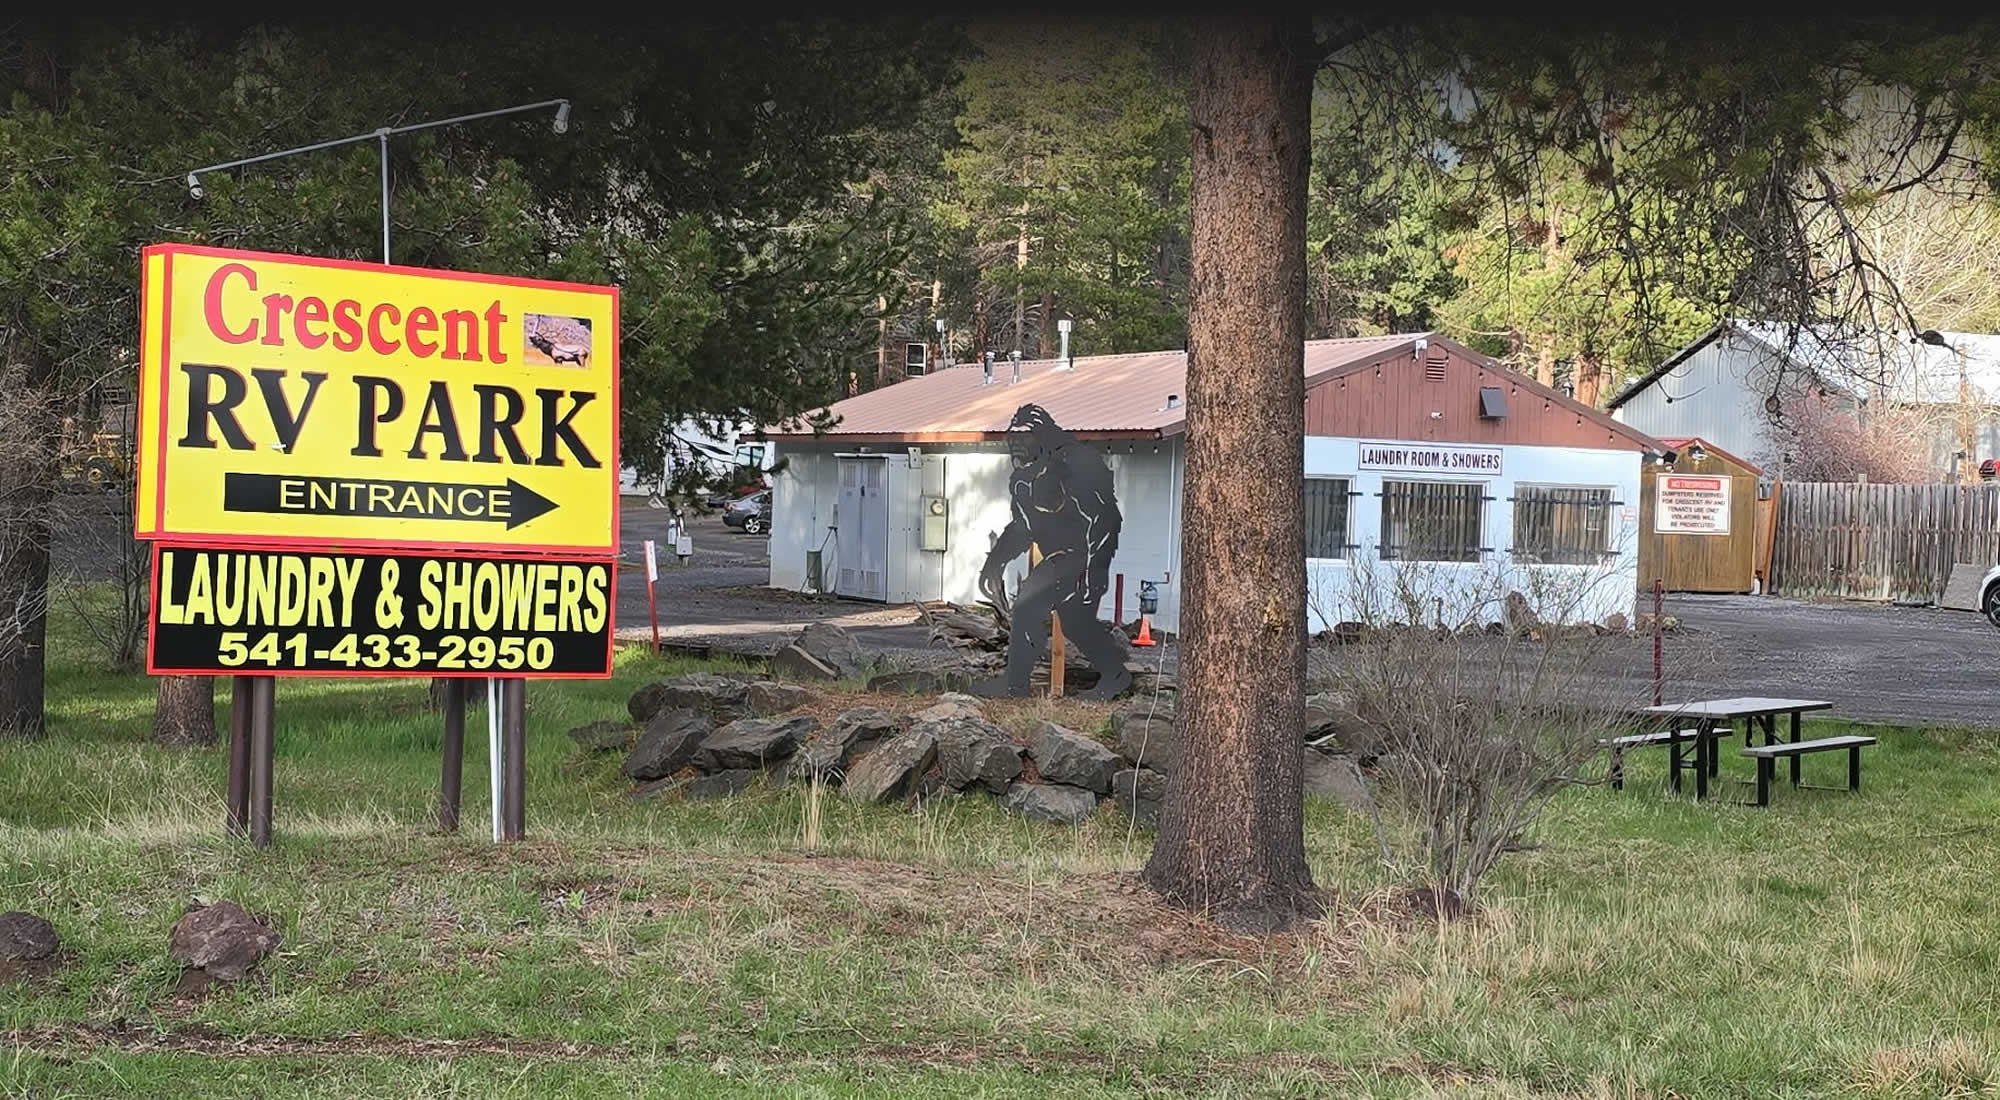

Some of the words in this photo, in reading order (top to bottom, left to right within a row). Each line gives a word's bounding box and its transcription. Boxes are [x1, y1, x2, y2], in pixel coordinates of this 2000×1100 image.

[204, 263, 507, 363] Crescent
[178, 363, 328, 454] RV
[351, 375, 602, 468] PARK
[1362, 449, 1409, 465] LAUNDRY
[1411, 452, 1440, 466] ROOM
[1442, 452, 1449, 467] &
[1452, 453, 1500, 469] SHOWERS
[279, 480, 512, 518] ENTRANCE
[159, 552, 365, 628] LAUNDRY
[375, 558, 404, 630] &
[418, 560, 607, 634] SHOWERS
[218, 632, 554, 670] 541-433-2950
